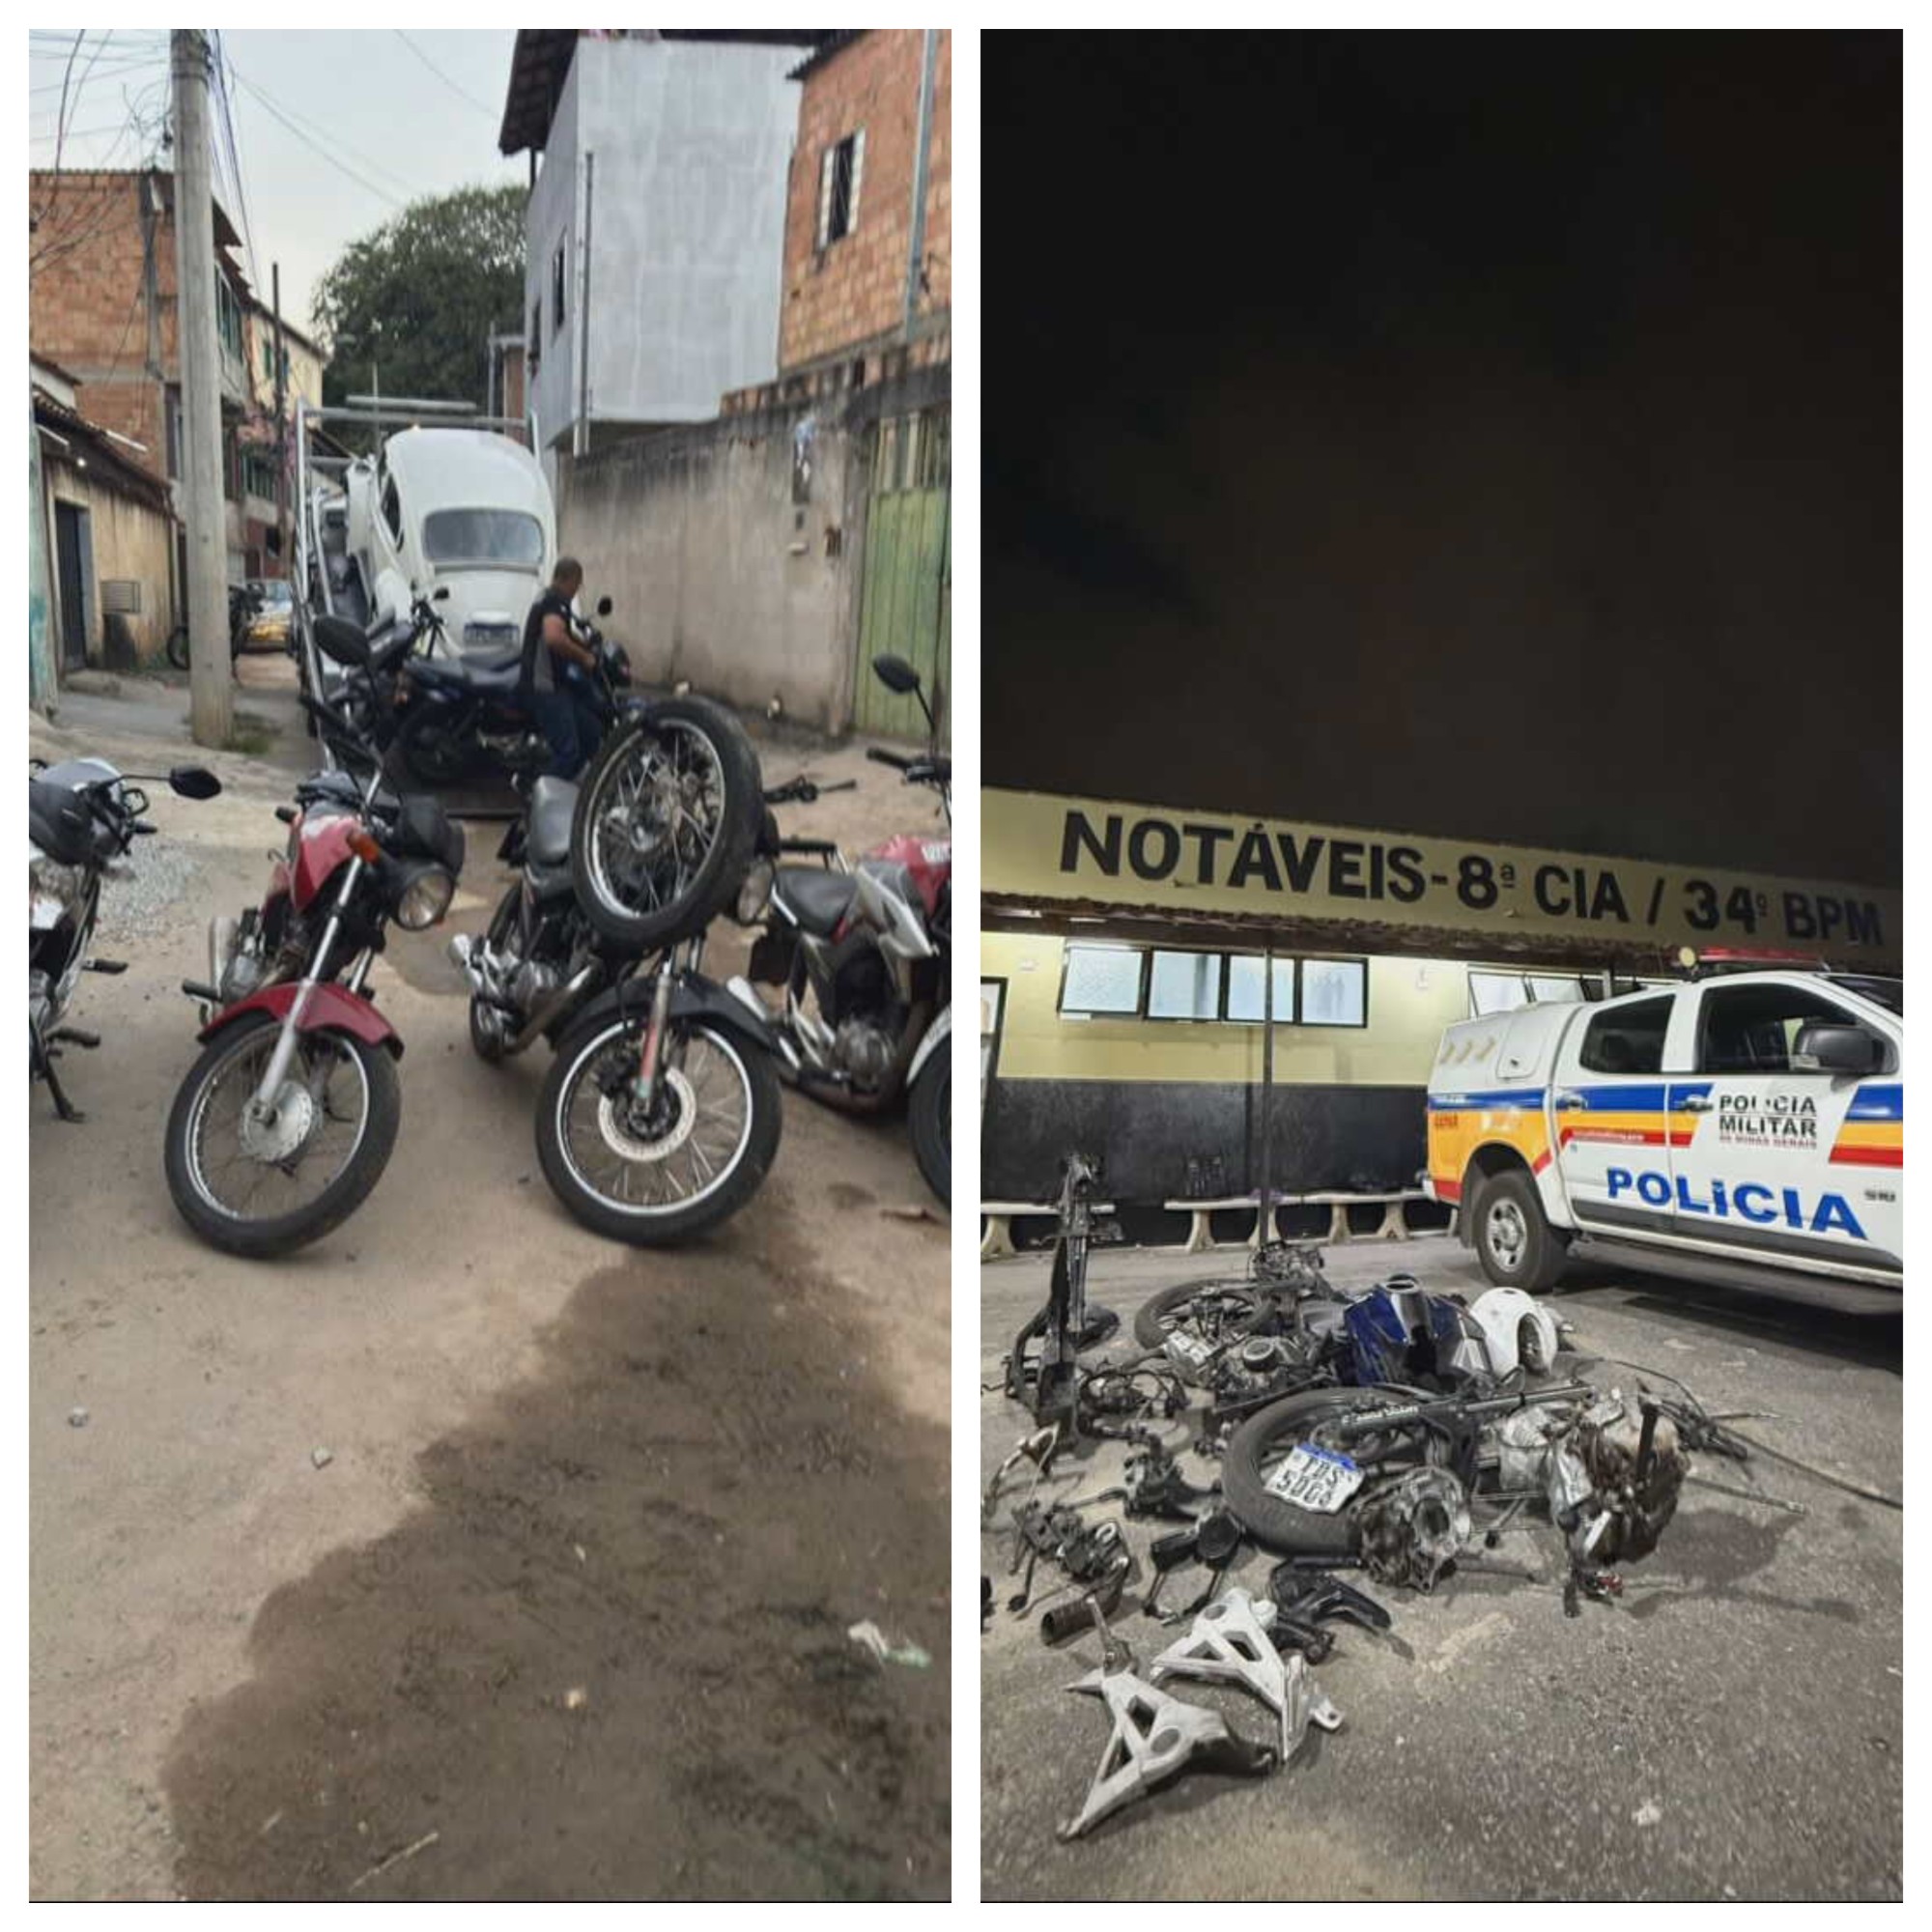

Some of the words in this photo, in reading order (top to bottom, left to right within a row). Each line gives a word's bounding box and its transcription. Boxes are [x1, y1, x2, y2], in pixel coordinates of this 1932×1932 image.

[1534, 865, 1630, 923] CIA
[1646, 876, 1665, 925] /
[1783, 891, 1884, 946] BPM
[1719, 1114, 1816, 1138] MILITAR
